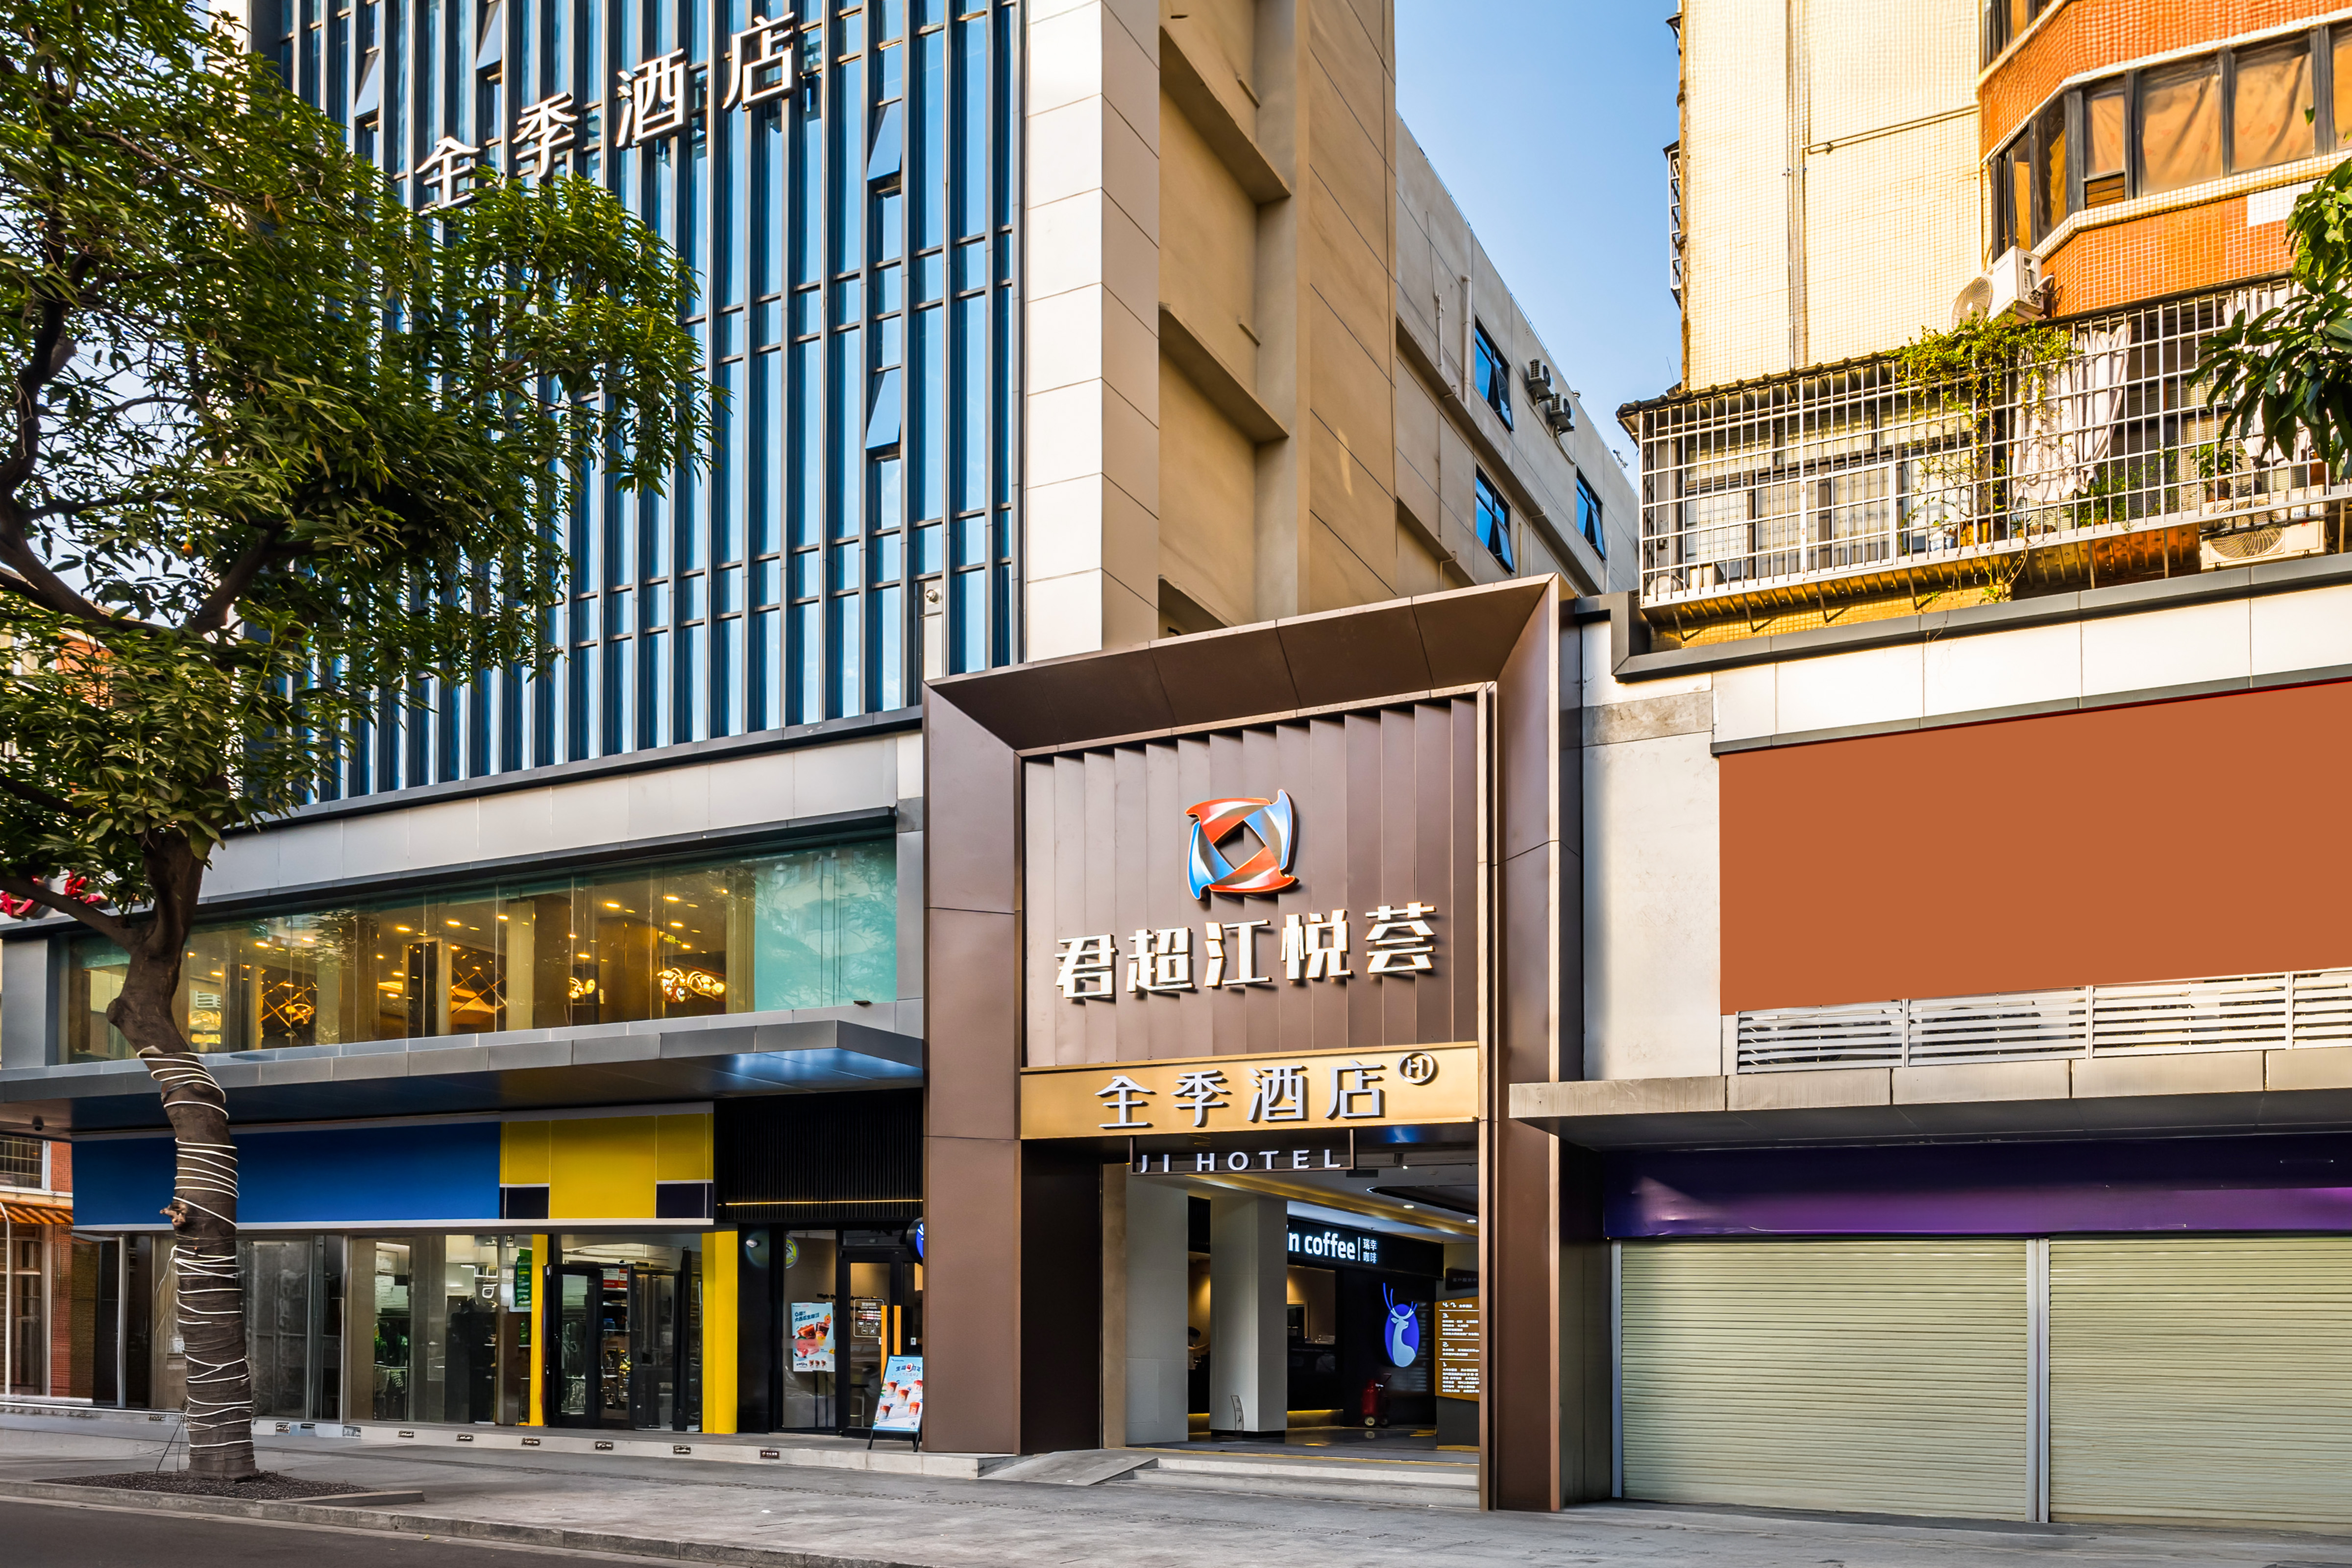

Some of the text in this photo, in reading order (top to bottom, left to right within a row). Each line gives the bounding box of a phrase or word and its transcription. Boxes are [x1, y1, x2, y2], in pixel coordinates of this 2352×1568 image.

[415, 11, 797, 216] 全季酒店
[1055, 902, 1438, 999] 君超江悦荟
[1094, 1059, 1387, 1129] 全季酒店
[1141, 1149, 1341, 1173] JI HOTEL
[1304, 1231, 1356, 1260] coffee
[1363, 1238, 1377, 1250] 瑞幸
[1363, 1251, 1377, 1264] 咖啡
